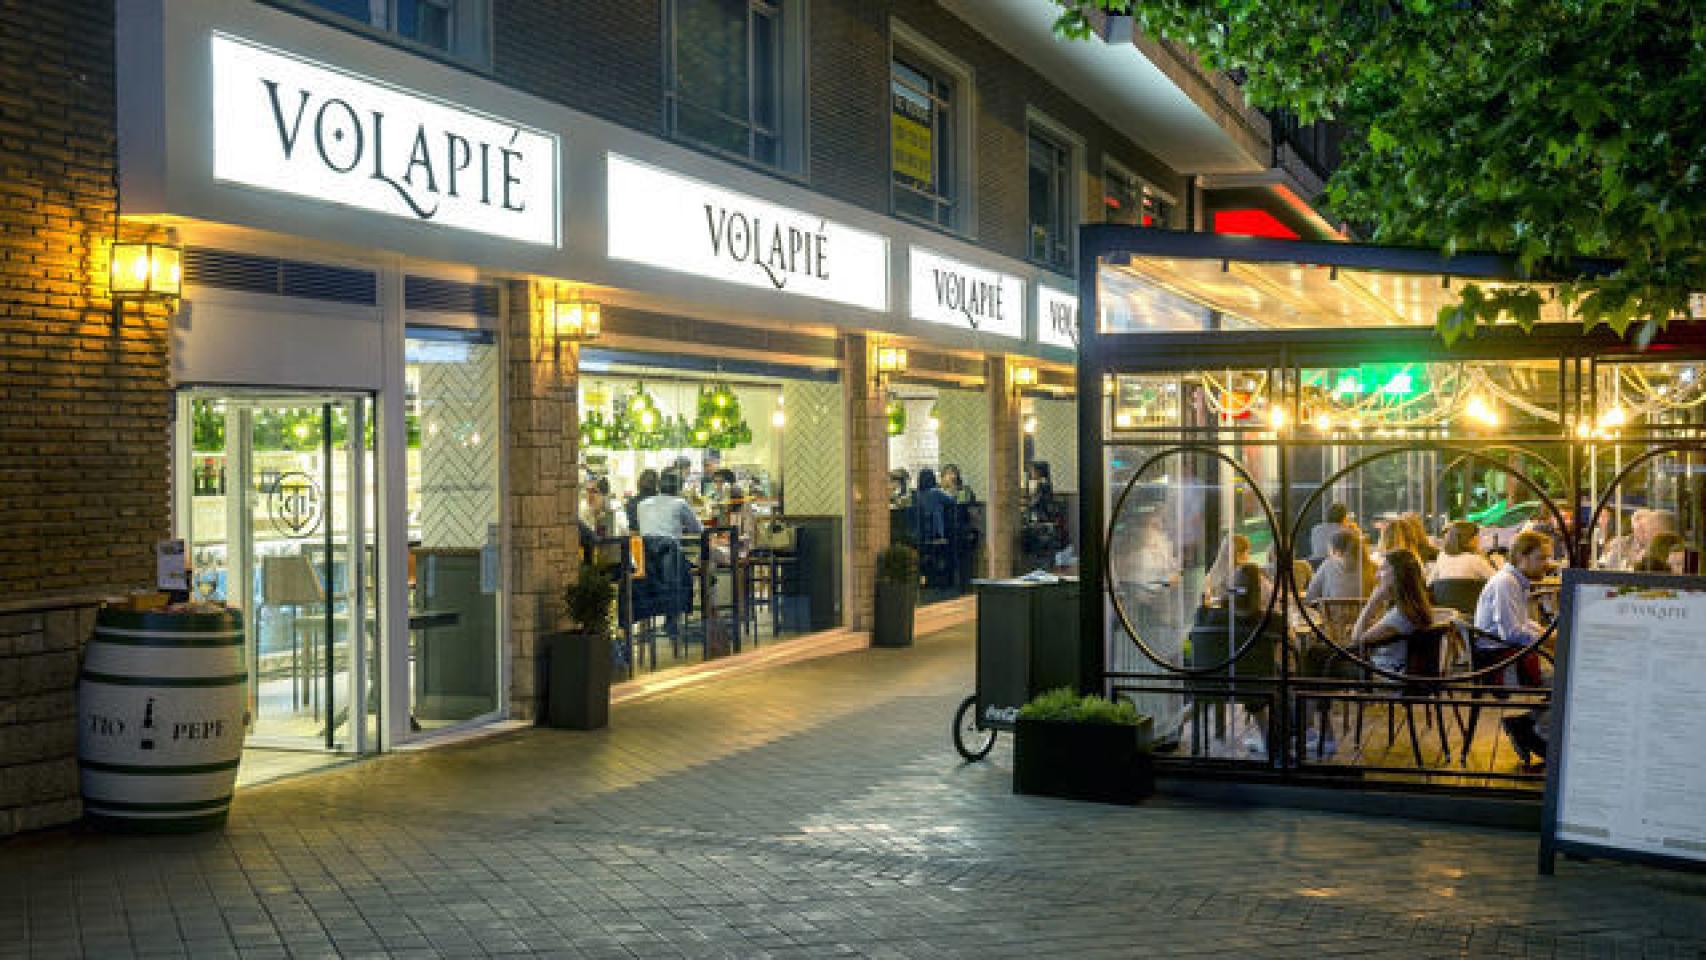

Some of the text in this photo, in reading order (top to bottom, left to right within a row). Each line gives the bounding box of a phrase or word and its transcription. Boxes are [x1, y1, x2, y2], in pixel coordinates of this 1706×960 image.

[259, 78, 526, 219] VOLAPIÉ
[703, 203, 829, 288] VOLAPIÉ
[934, 268, 1004, 328] VOLAPIÉ
